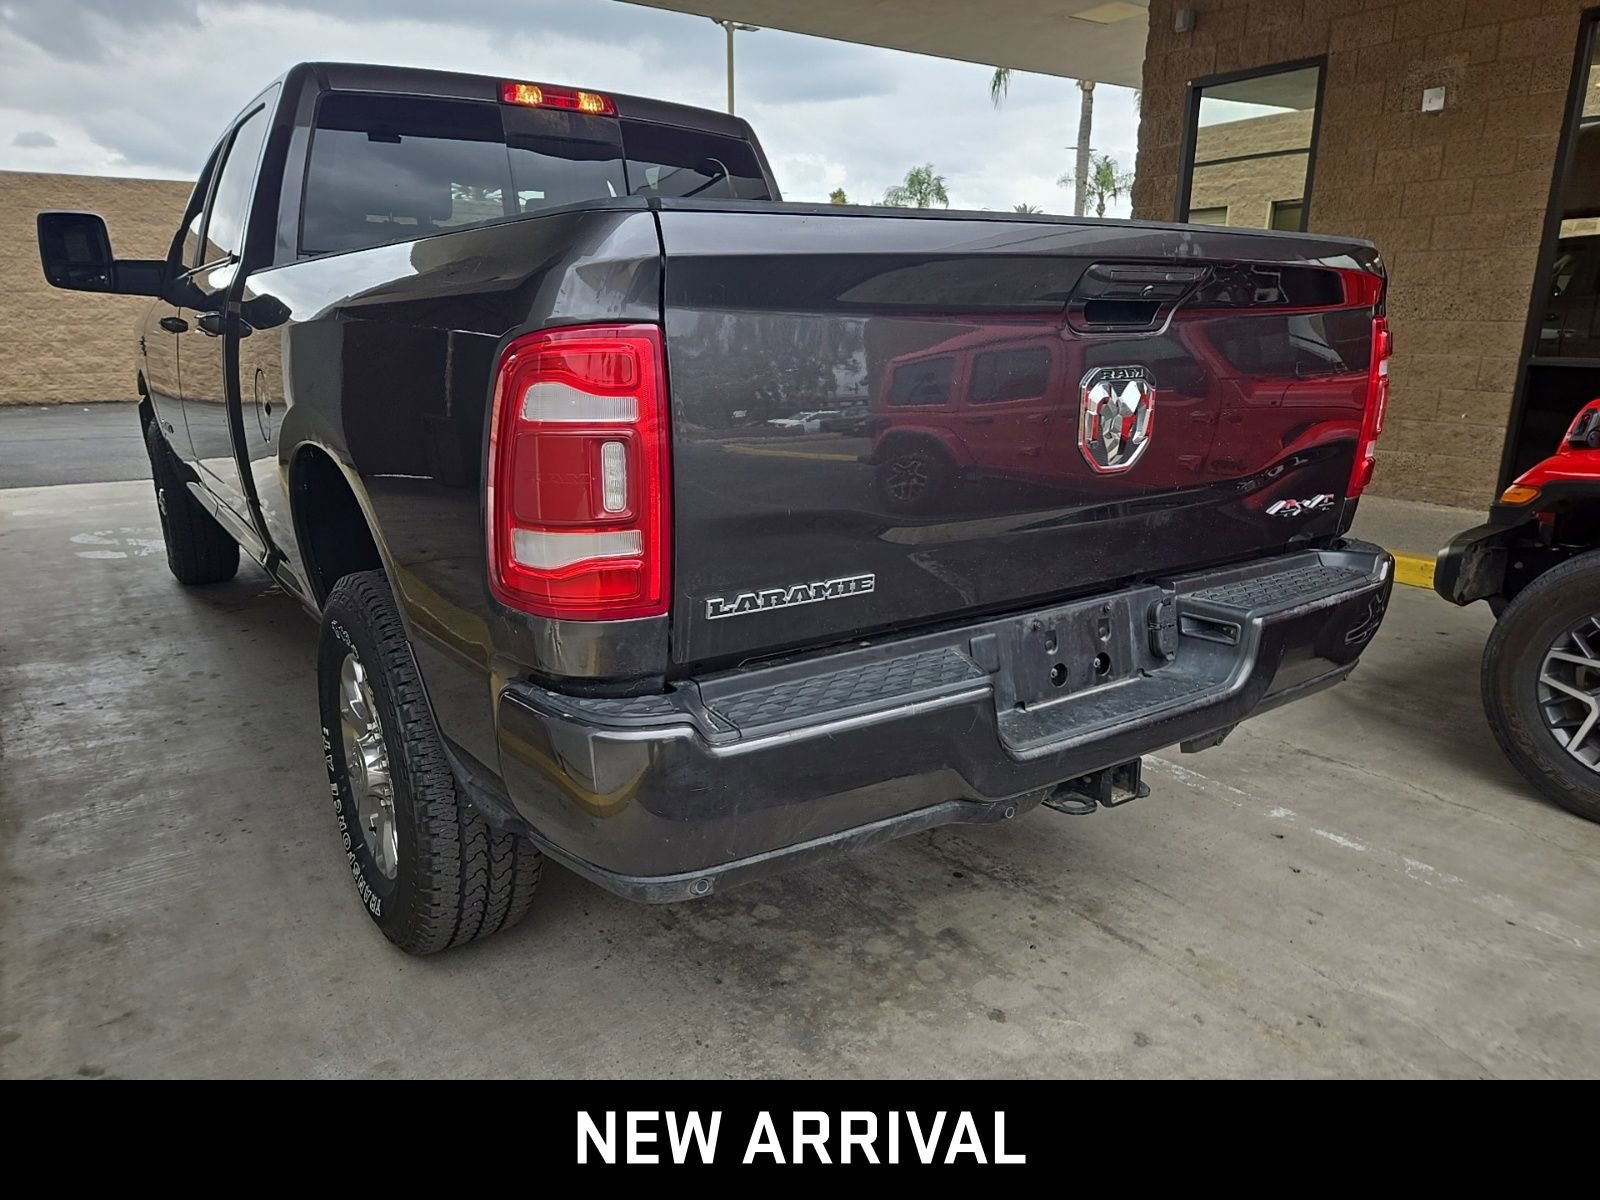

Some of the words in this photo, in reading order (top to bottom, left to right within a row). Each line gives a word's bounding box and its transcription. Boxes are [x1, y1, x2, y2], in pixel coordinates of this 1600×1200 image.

[1101, 368, 1144, 379] RAM
[706, 573, 876, 619] LARAMIE
[330, 783, 382, 917] TRANSFORCE
